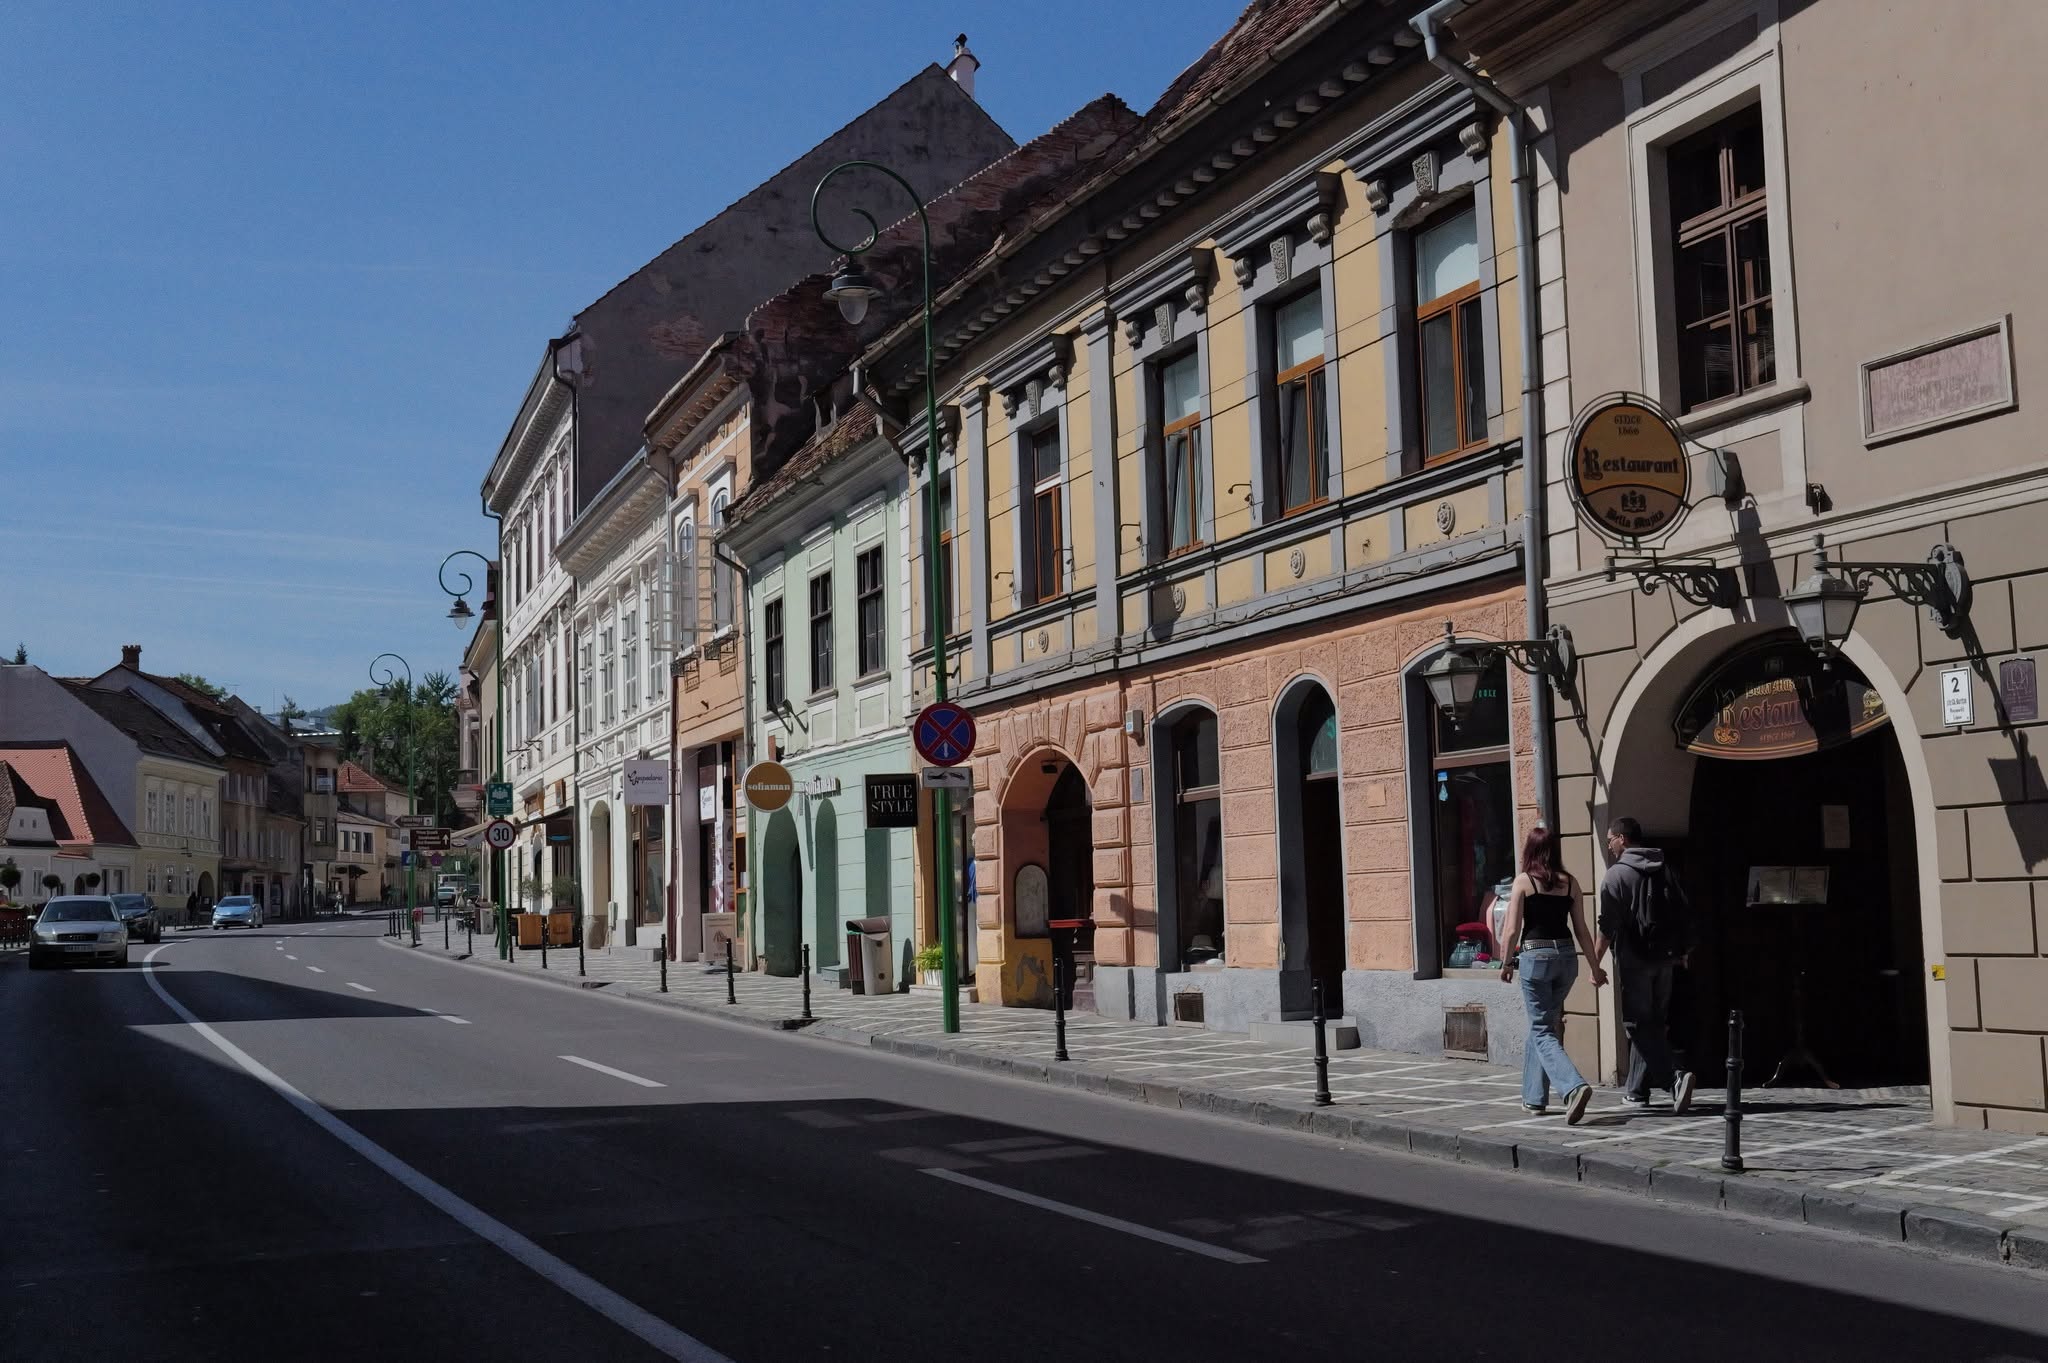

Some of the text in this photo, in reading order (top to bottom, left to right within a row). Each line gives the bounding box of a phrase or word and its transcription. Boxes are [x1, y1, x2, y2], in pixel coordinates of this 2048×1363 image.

[1583, 447, 1680, 480] Restaurant
[1951, 676, 1960, 693] 2
[871, 784, 913, 800] TRUE
[871, 800, 913, 814] STYLE
[493, 828, 510, 842] 30
